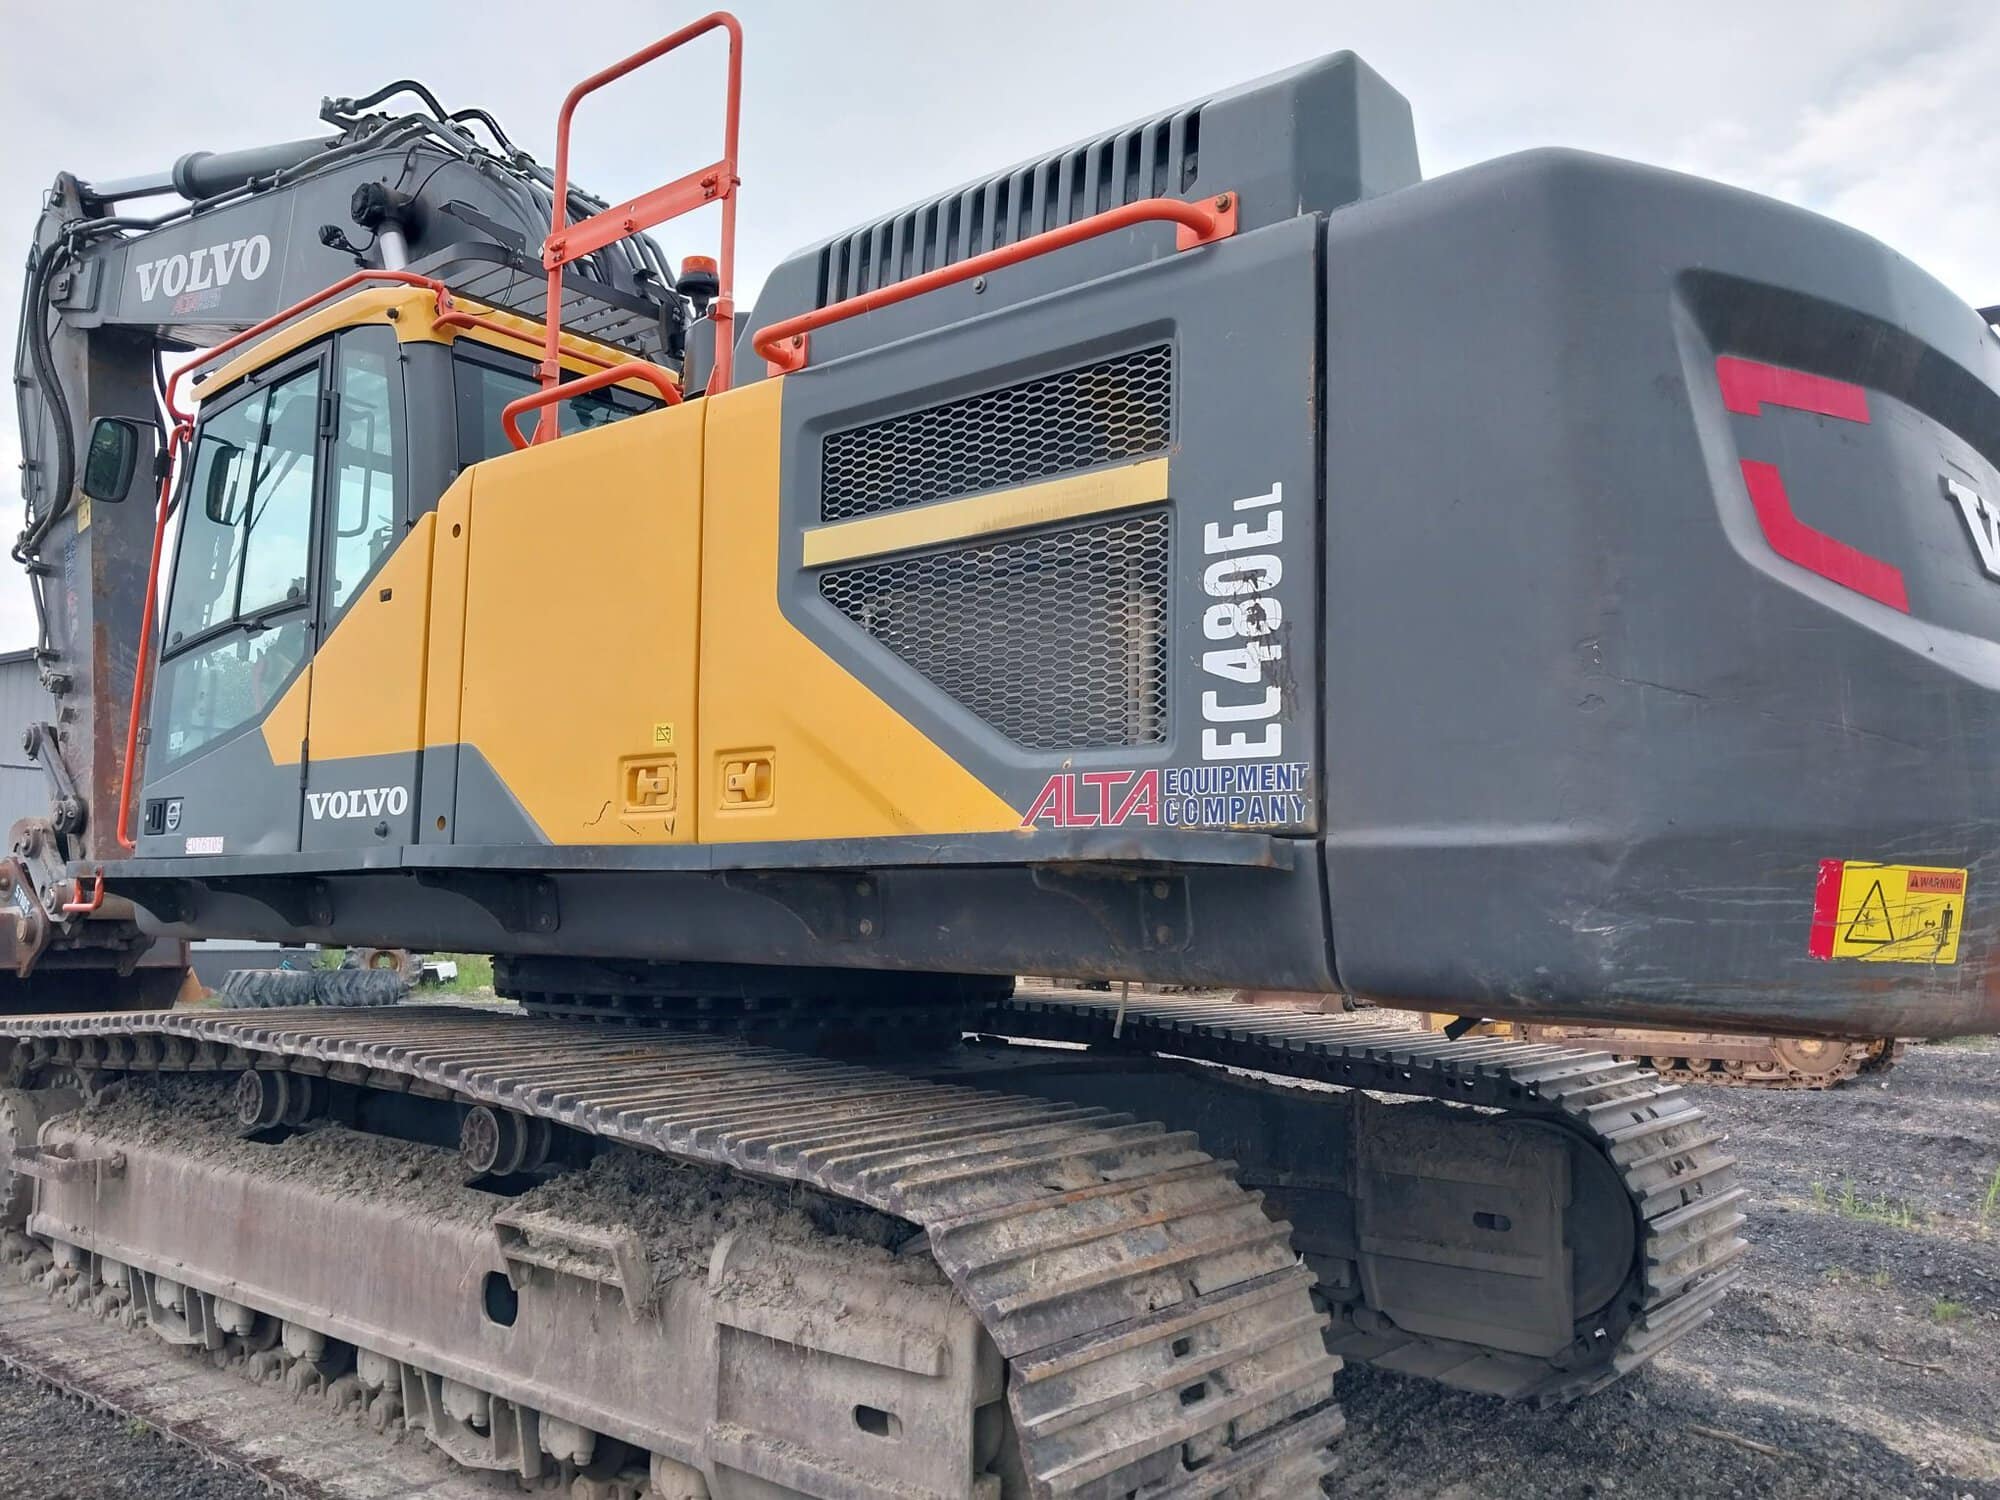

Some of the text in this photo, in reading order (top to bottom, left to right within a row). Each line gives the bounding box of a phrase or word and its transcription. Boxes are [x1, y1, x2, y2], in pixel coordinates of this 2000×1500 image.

[136, 235, 270, 302] VOLVO
[1164, 762, 1309, 796] EQUIPMENT
[307, 786, 408, 820] VOLVO
[1020, 769, 1159, 827] ALTA
[1164, 793, 1305, 826] COMPANY
[1919, 876, 1961, 890] WARNING
